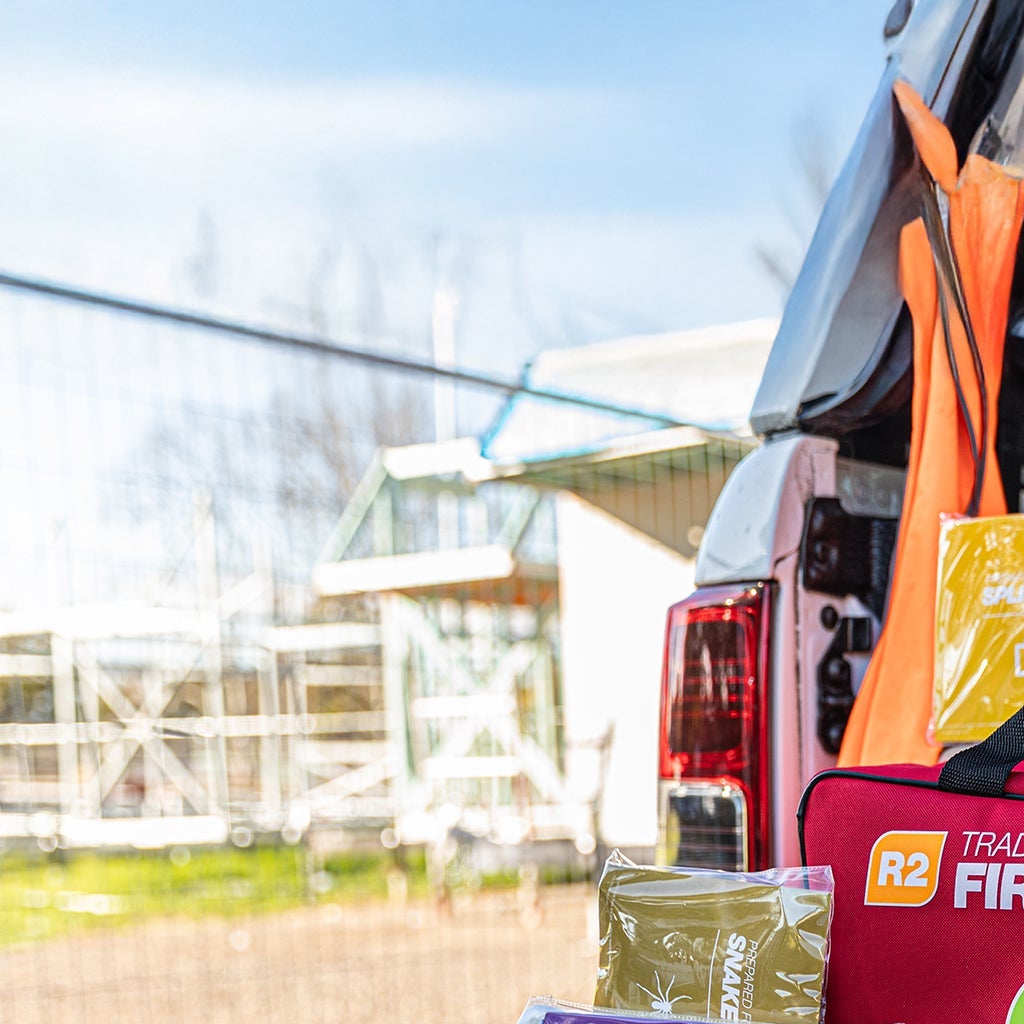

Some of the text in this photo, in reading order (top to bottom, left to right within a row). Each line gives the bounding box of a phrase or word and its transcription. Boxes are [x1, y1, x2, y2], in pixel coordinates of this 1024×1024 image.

[877, 849, 930, 888] R2
[720, 932, 747, 1022] SNAKE
[741, 939, 759, 1009] PREPARED
